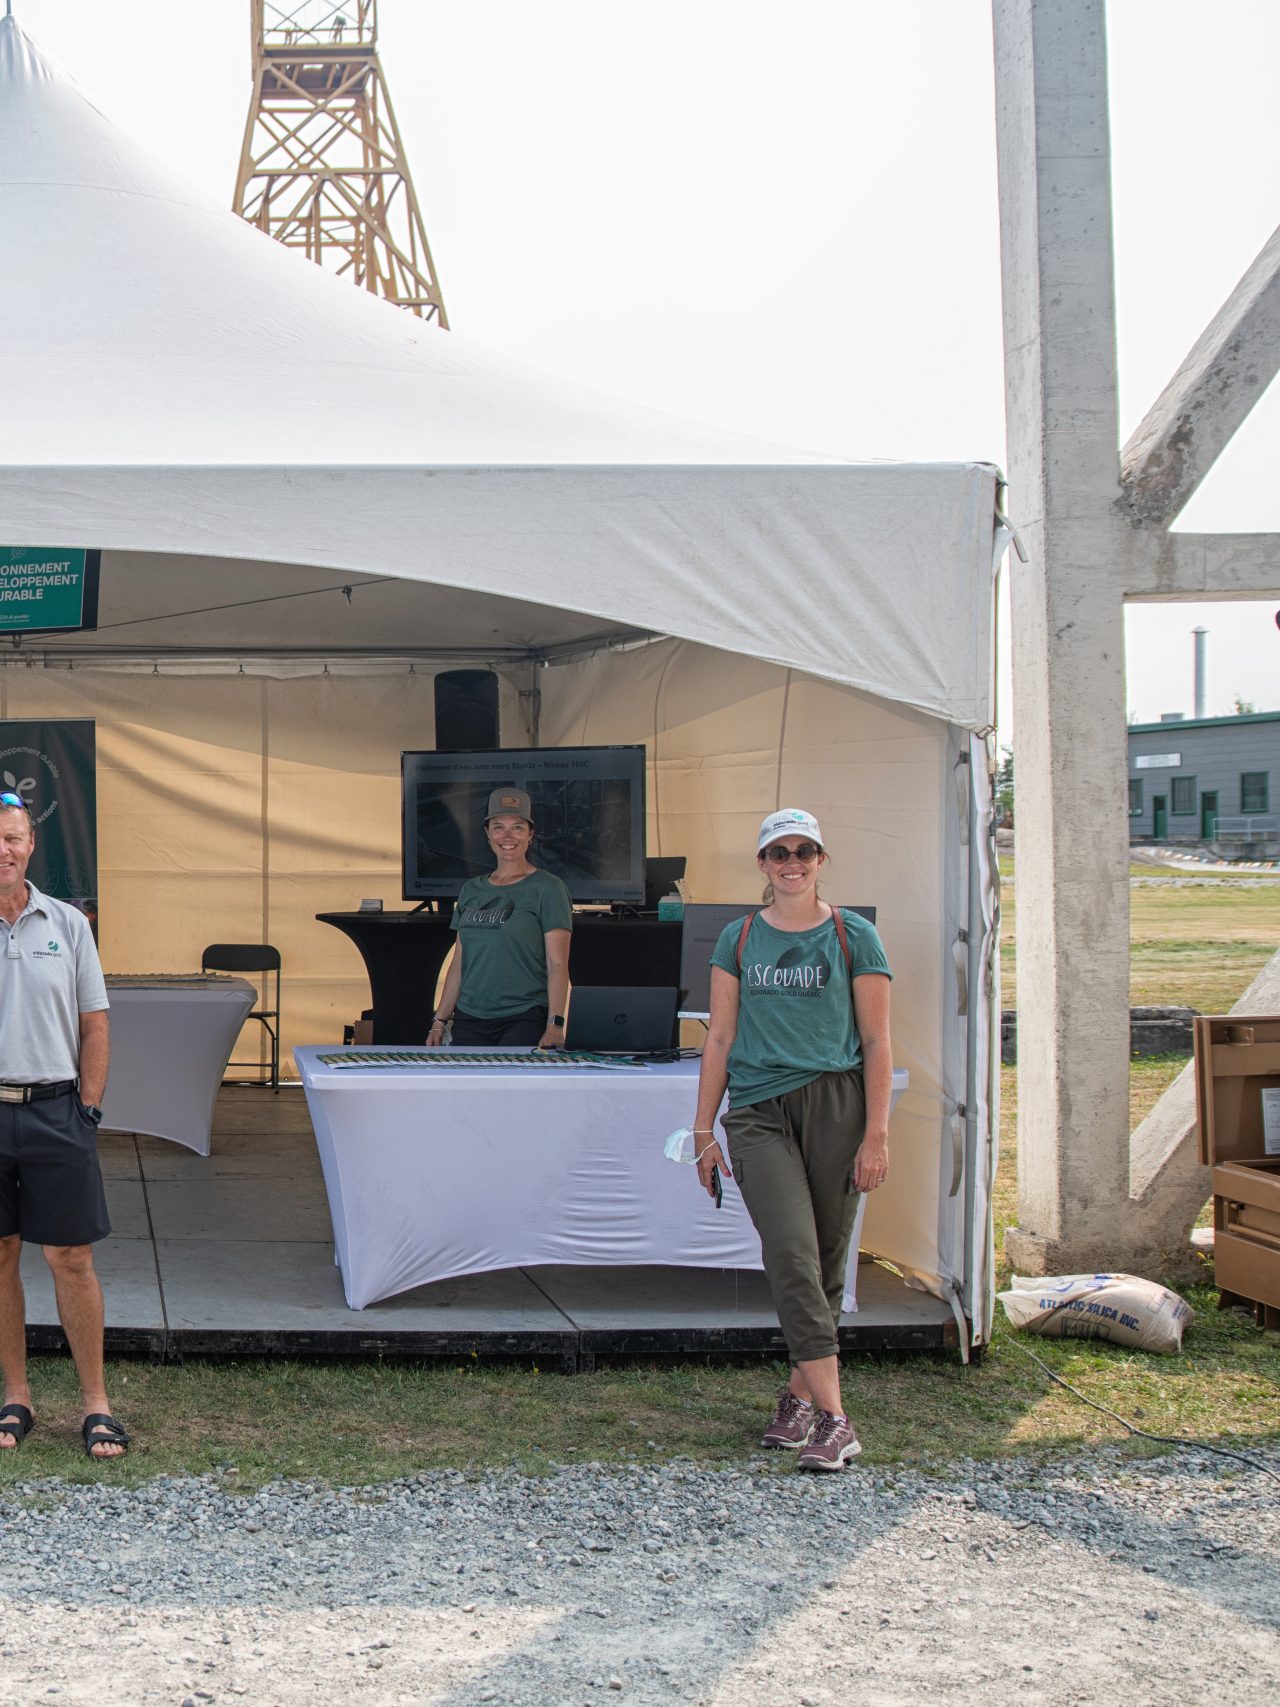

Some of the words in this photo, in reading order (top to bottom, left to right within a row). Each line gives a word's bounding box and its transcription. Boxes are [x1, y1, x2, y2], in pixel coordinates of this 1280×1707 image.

[40, 754, 59, 778] durable
[37, 800, 58, 823] actions
[747, 963, 825, 989] ESCOUADE
[1086, 1302, 1118, 1321] SILICA
[1119, 1313, 1139, 1331] INC.
